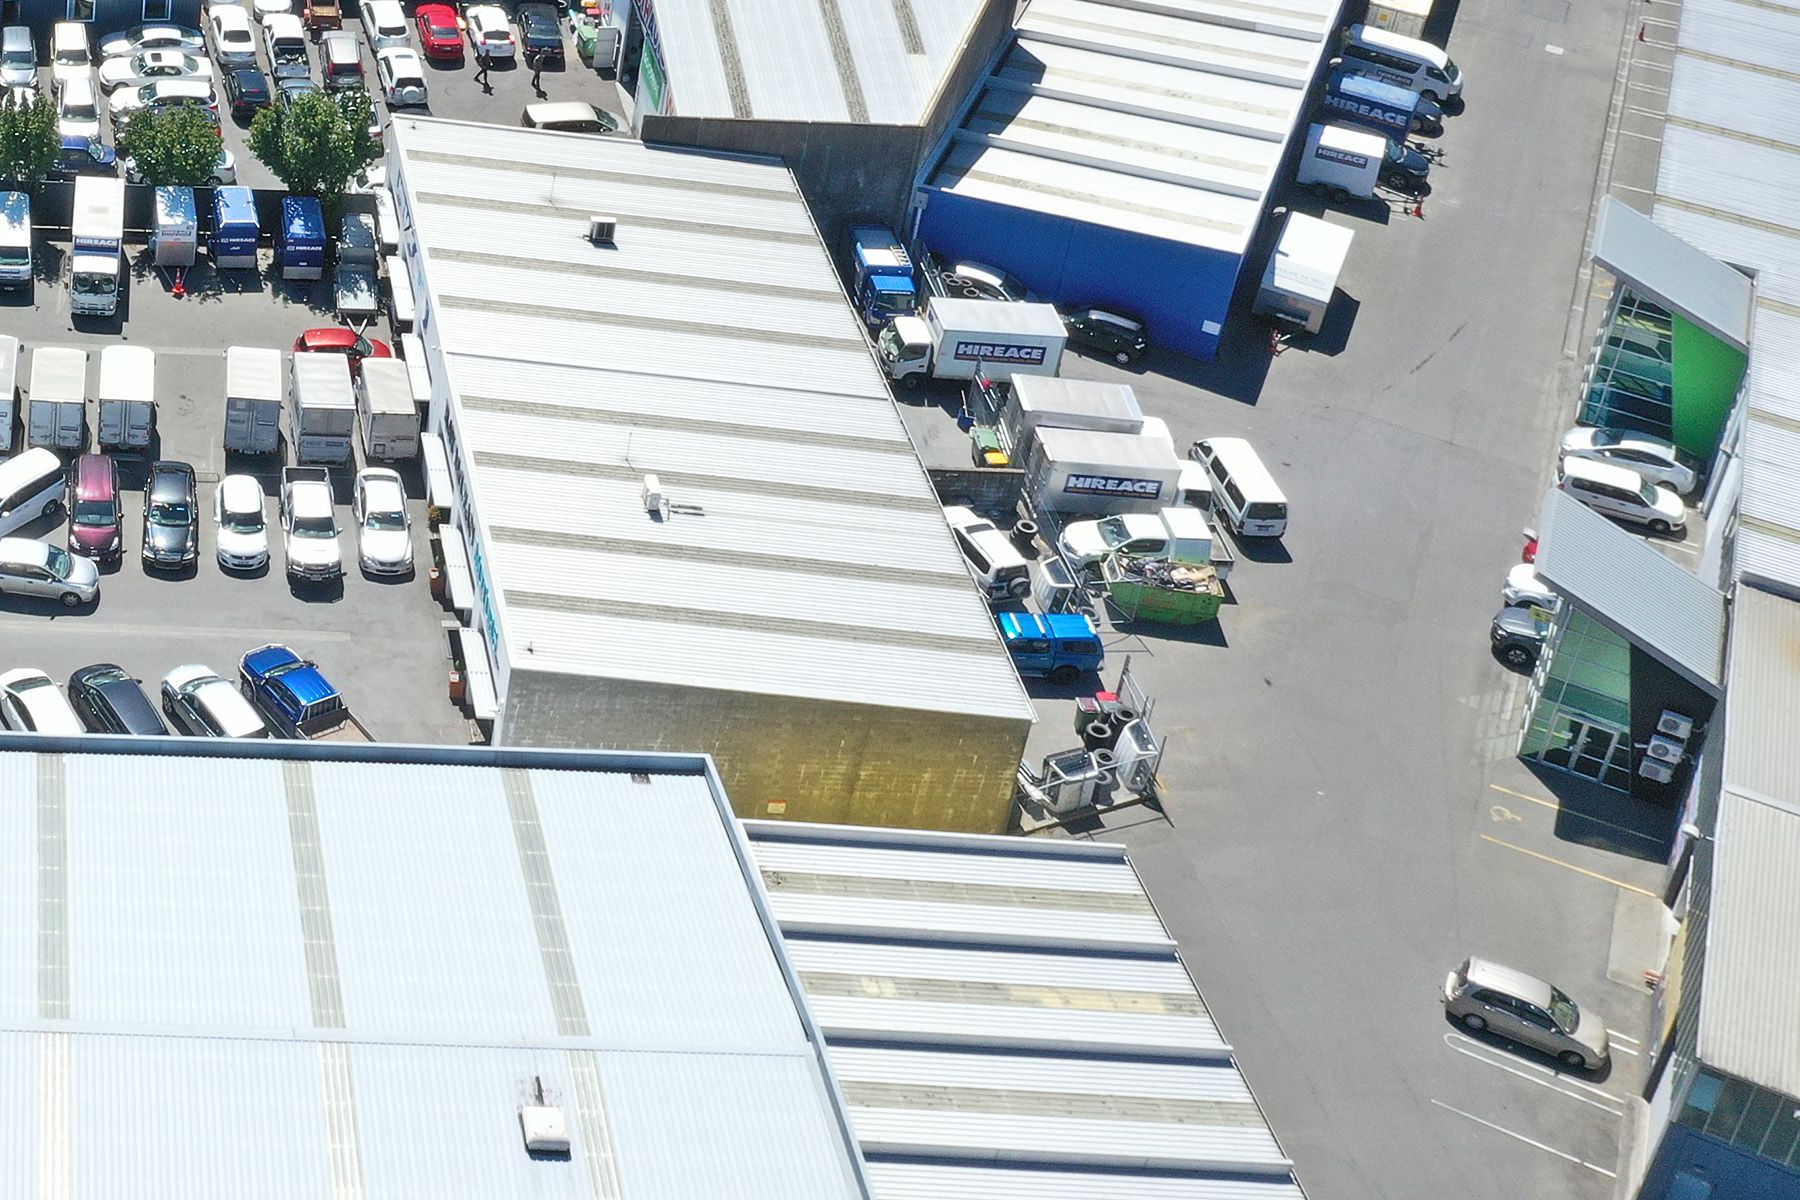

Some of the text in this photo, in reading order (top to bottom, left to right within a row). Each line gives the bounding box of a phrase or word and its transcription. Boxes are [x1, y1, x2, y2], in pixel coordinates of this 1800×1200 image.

[1323, 94, 1408, 126] HIREACE
[1317, 148, 1367, 165] HIREACE
[76, 238, 118, 246] HIREACE
[956, 343, 1044, 360] HIREACE
[1067, 476, 1158, 494] HIREACE
